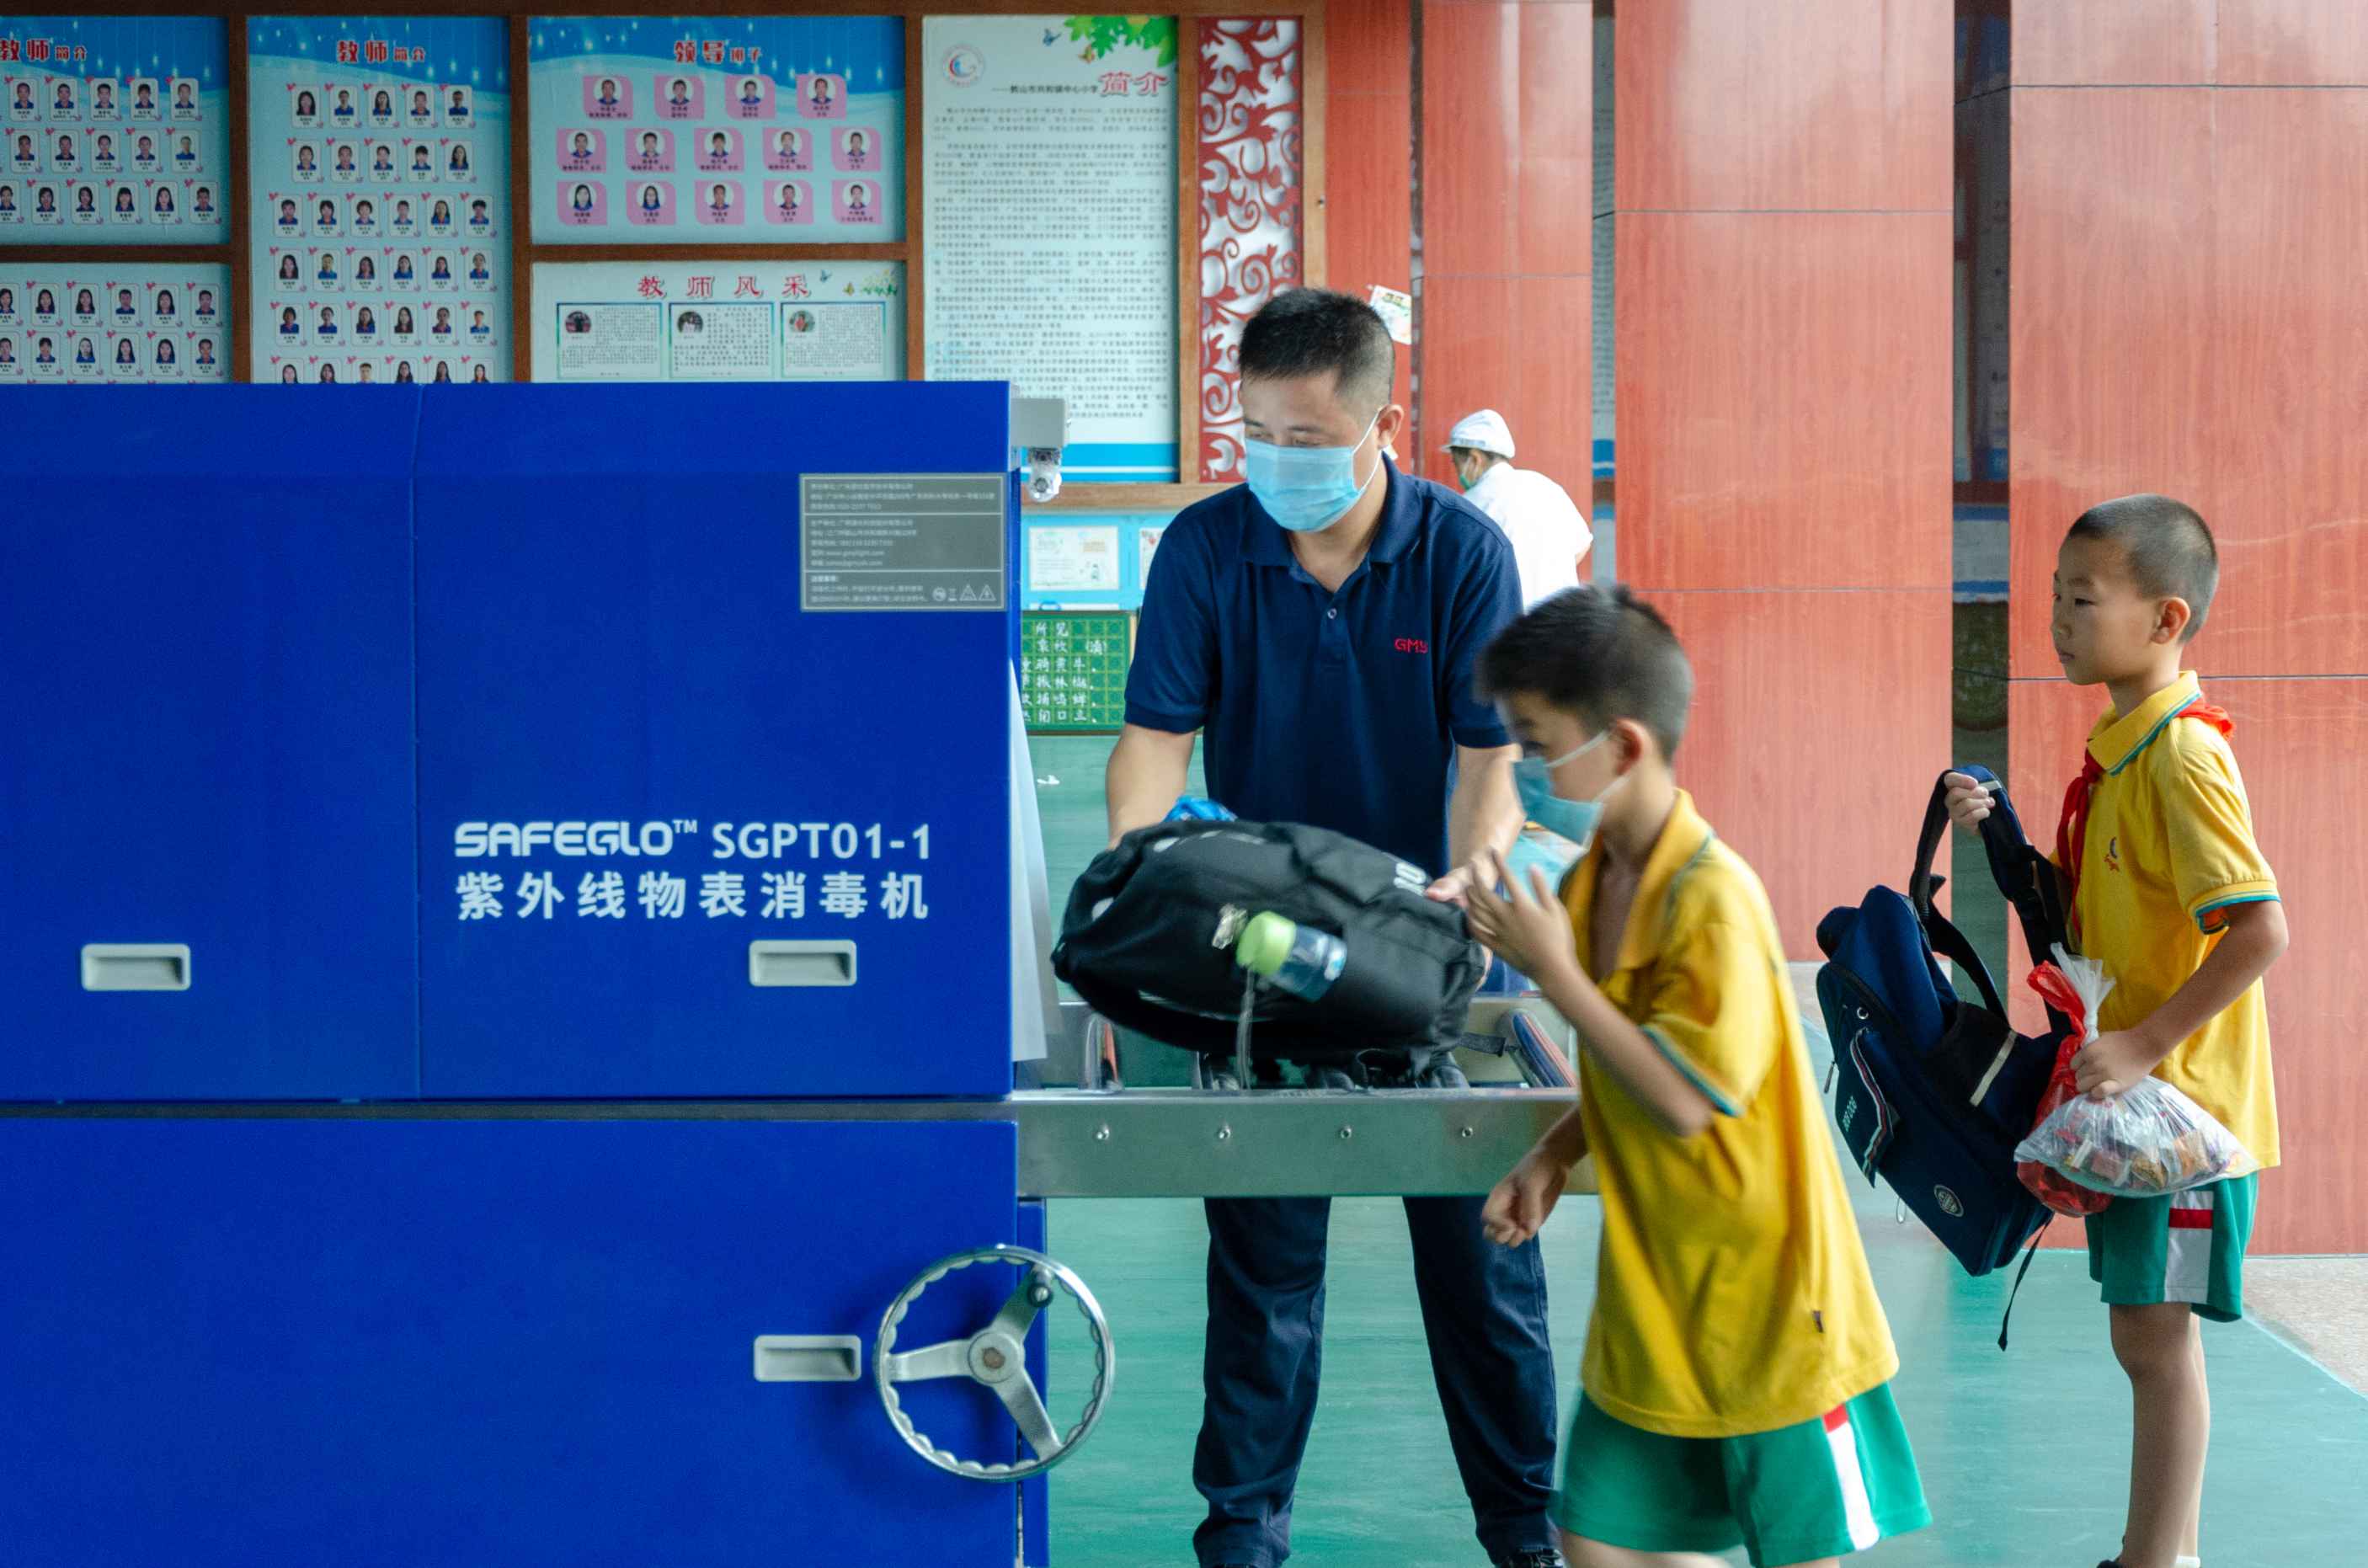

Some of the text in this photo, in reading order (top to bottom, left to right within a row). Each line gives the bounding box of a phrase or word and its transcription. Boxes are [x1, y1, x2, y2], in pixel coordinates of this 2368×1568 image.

[1098, 71, 1169, 97] 简介
[637, 275, 812, 299] 教师风采
[712, 822, 930, 860] SGPT01-1
[456, 871, 929, 920] 紫外线物表消毒机
